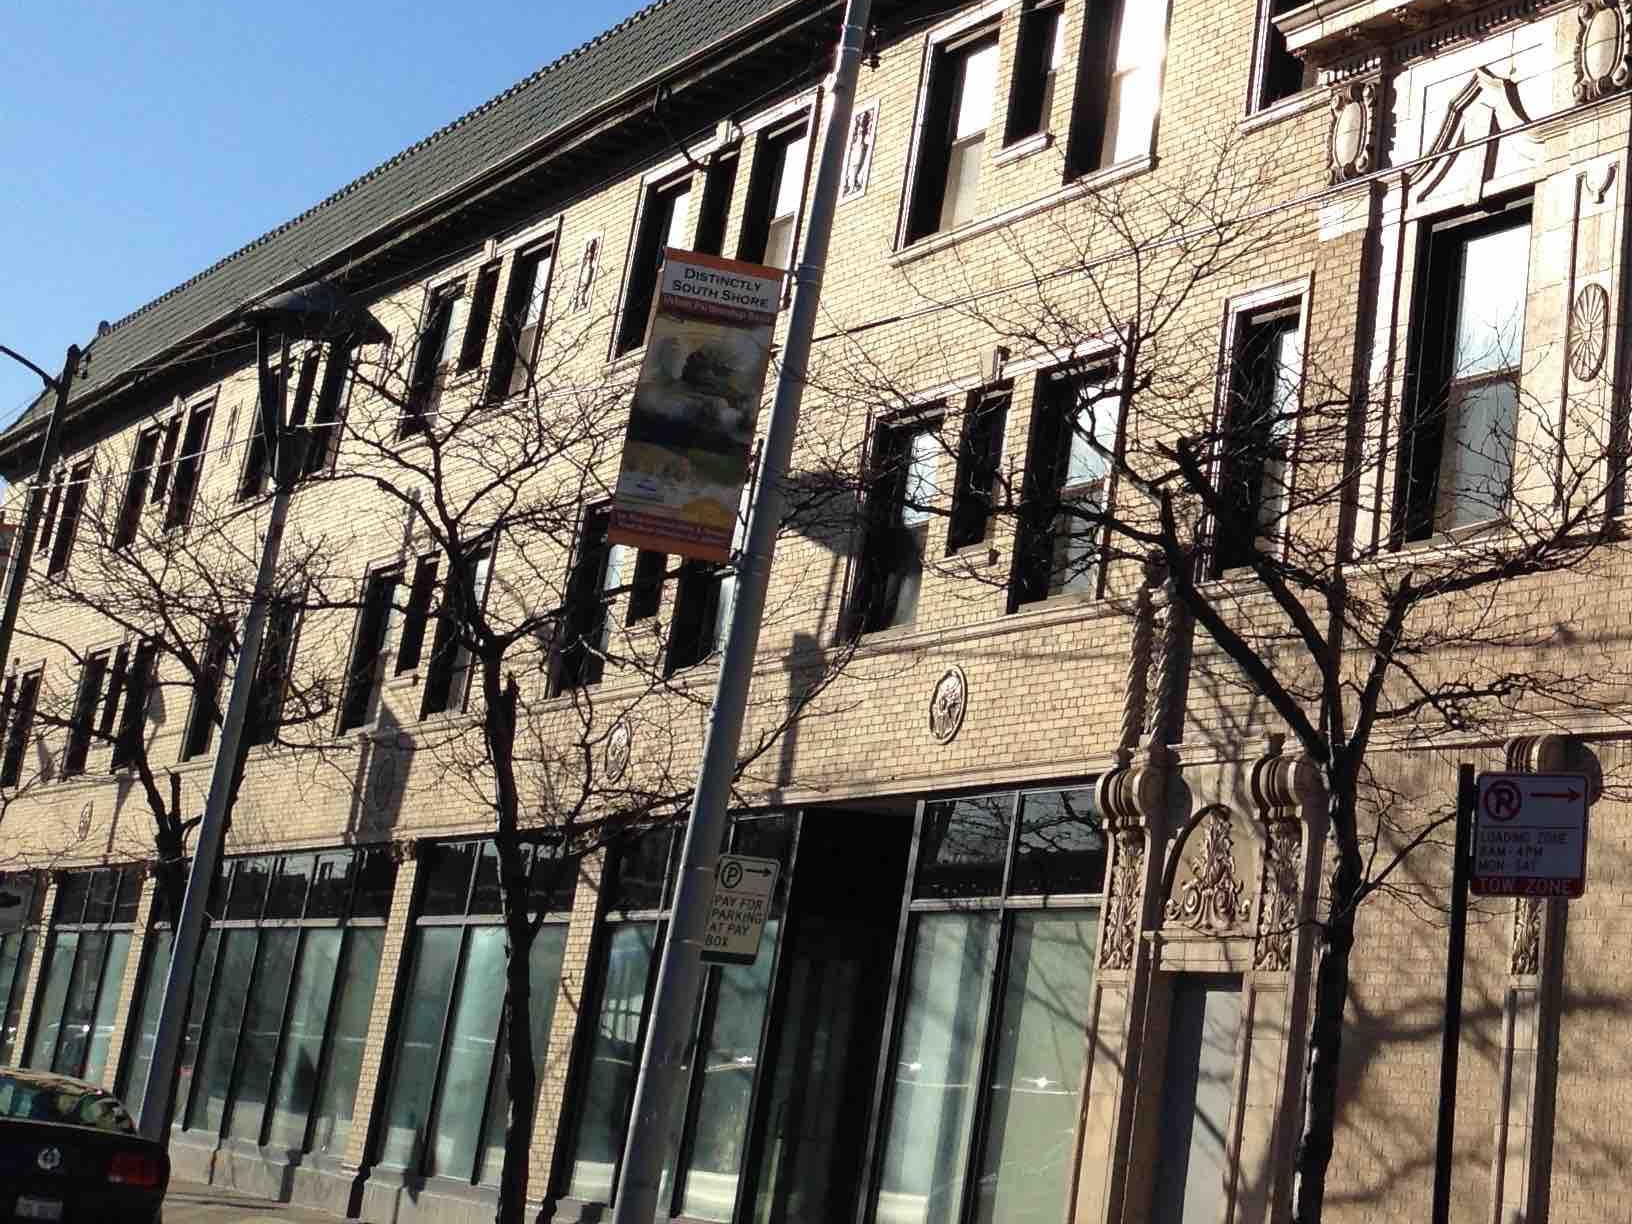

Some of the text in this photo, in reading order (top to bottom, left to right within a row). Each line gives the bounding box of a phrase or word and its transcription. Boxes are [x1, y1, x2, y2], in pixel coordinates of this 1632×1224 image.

[684, 266, 762, 292] DISTINCTLY
[671, 279, 769, 309] SOUTH SHORE
[1479, 878, 1572, 894] TOW ZONE
[714, 895, 764, 911] PAY FOR
[711, 908, 762, 925] PARKING
[709, 921, 750, 935] AT PAY
[705, 934, 729, 947] BOX
